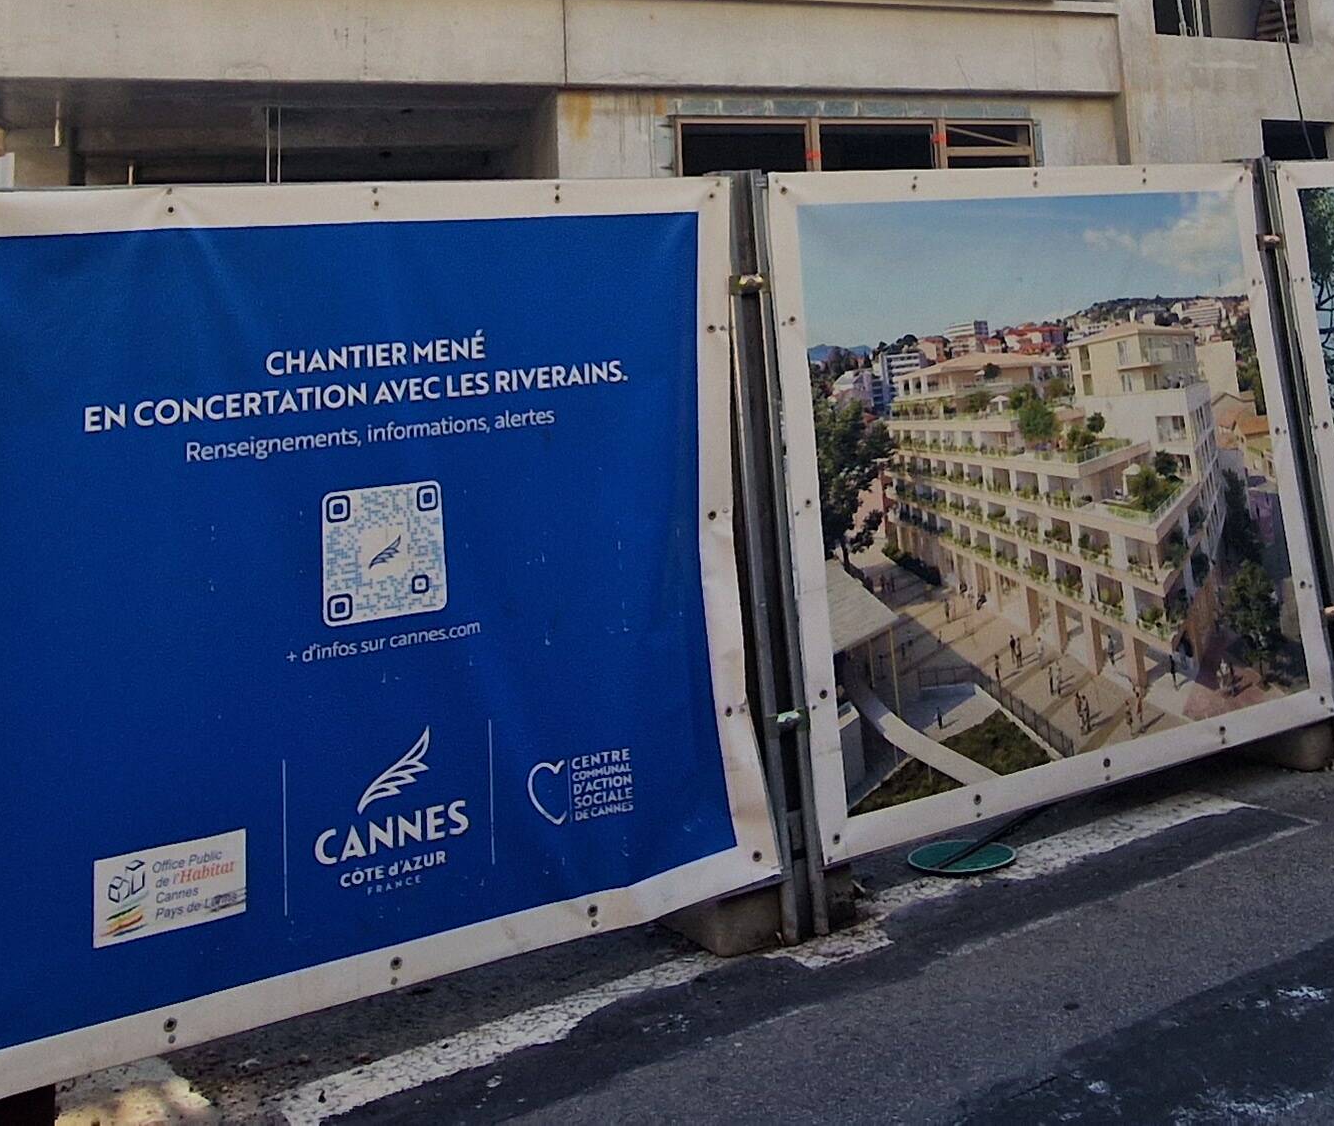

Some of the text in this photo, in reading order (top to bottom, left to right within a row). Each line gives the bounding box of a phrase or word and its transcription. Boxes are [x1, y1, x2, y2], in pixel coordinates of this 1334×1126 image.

[266, 329, 486, 376] CHANTIER MENÉ
[84, 360, 629, 432] EN CONCERTATION AVEC LES RIVERAINS.
[186, 409, 555, 462] Renseignements, informations, alertes
[286, 621, 481, 663] + d'infos sur cannes.com
[571, 748, 631, 770] CENTRE
[572, 763, 632, 782] COMMUNAL
[573, 773, 633, 796] D'ACTION
[574, 786, 633, 809] SOCIALE
[575, 800, 634, 821] DE CANNES
[314, 800, 469, 865] CANNES
[152, 850, 223, 874] Office Public
[340, 850, 447, 888] CÔTE d'AZUR
[155, 860, 235, 888] de l'Habitat
[367, 874, 422, 895] FRANCE
[156, 887, 199, 904] Cannes
[155, 905, 184, 920] Pays
[187, 902, 202, 913] de
